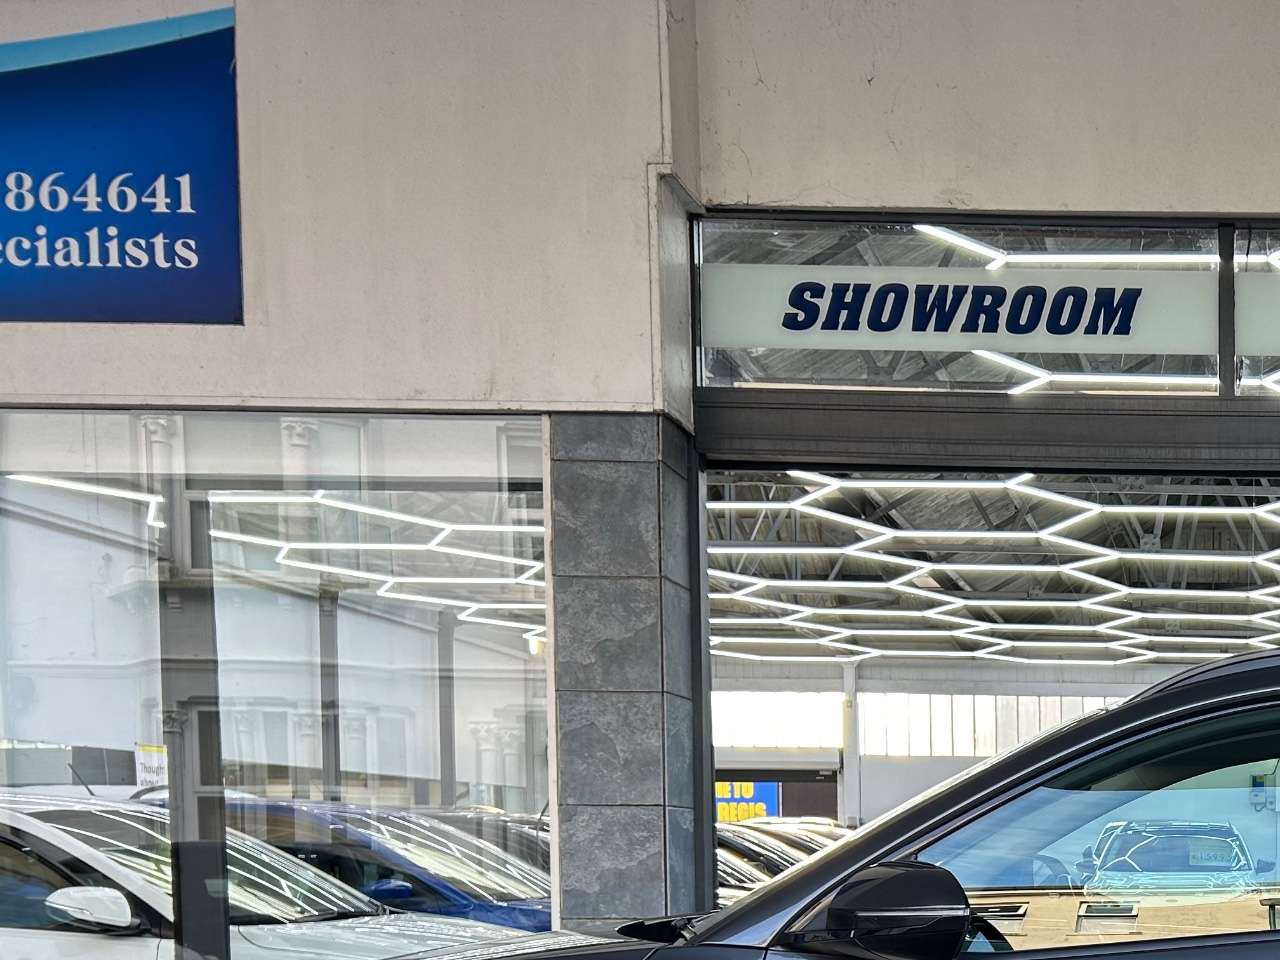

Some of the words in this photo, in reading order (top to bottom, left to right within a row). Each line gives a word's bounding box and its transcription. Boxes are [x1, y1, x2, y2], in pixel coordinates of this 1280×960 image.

[5, 172, 196, 213] 864641
[0, 225, 199, 269] cialists
[782, 281, 1143, 335] SHOWROOM
